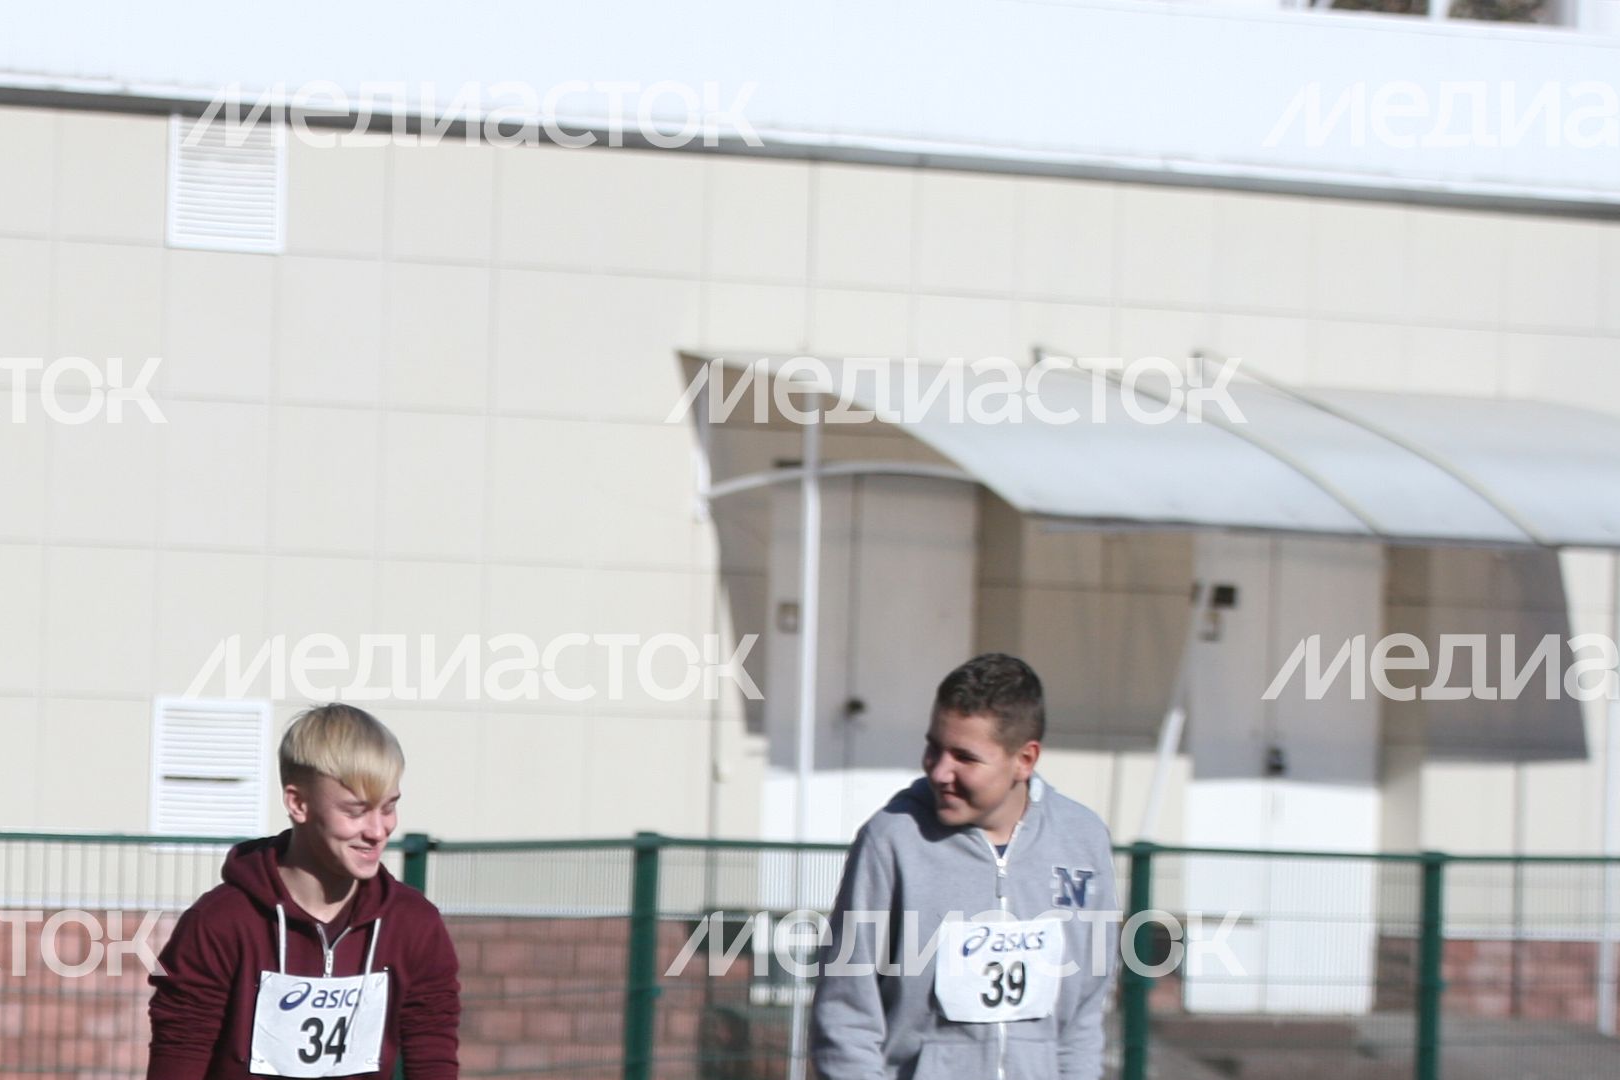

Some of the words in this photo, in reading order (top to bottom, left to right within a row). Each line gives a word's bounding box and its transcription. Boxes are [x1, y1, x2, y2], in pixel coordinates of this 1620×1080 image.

[1051, 866, 1096, 908] N
[991, 931, 1045, 952] asics
[310, 987, 362, 1009] asic
[980, 961, 1026, 1008] 39
[297, 1015, 347, 1065] 34
